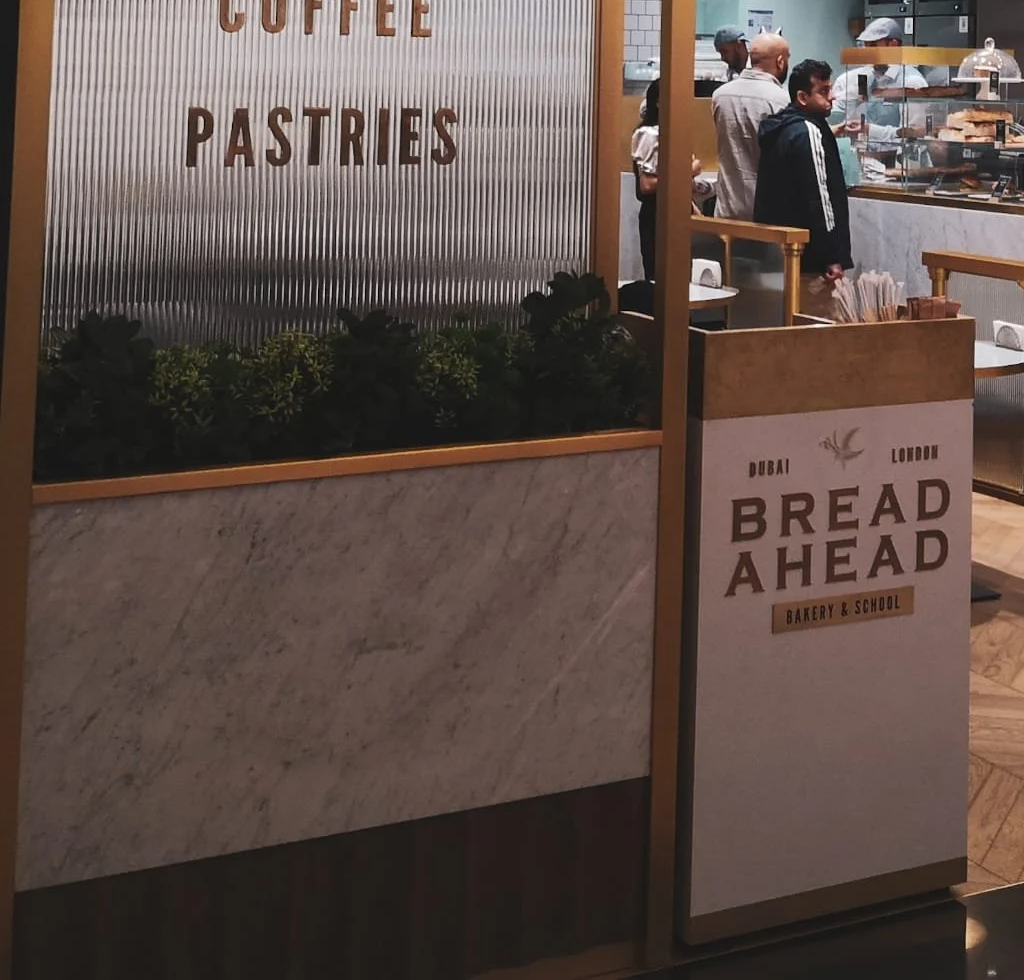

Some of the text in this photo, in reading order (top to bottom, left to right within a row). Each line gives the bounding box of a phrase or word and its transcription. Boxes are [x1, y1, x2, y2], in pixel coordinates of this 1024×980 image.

[185, 107, 458, 168] PASTRIES
[749, 458, 790, 478] DUBAI
[892, 445, 938, 463] LONDON
[731, 478, 950, 543] BREAD
[724, 529, 949, 597] AHEAD
[786, 594, 901, 625] BAKERY & SCHOOL
